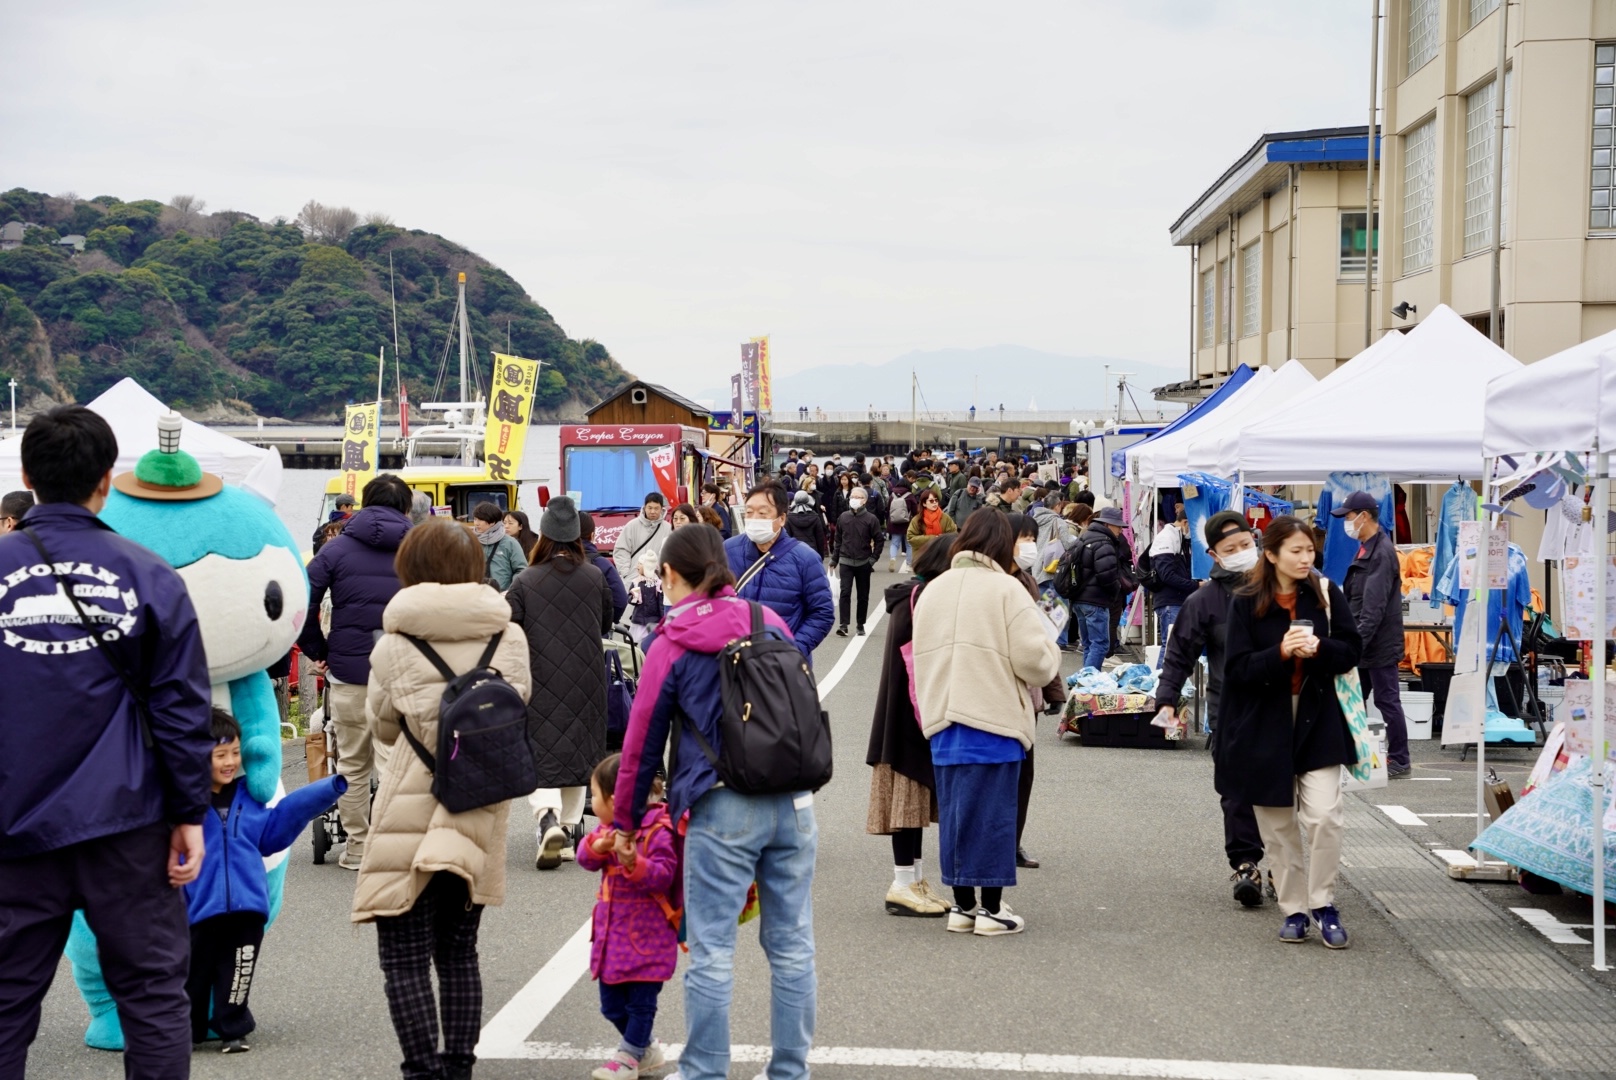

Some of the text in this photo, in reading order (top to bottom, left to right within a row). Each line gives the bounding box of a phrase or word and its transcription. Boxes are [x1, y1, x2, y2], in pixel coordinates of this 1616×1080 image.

[575, 427, 665, 444] Crepes Crayon
[50, 614, 97, 625] FUJISAA
[241, 960, 253, 975] TO
